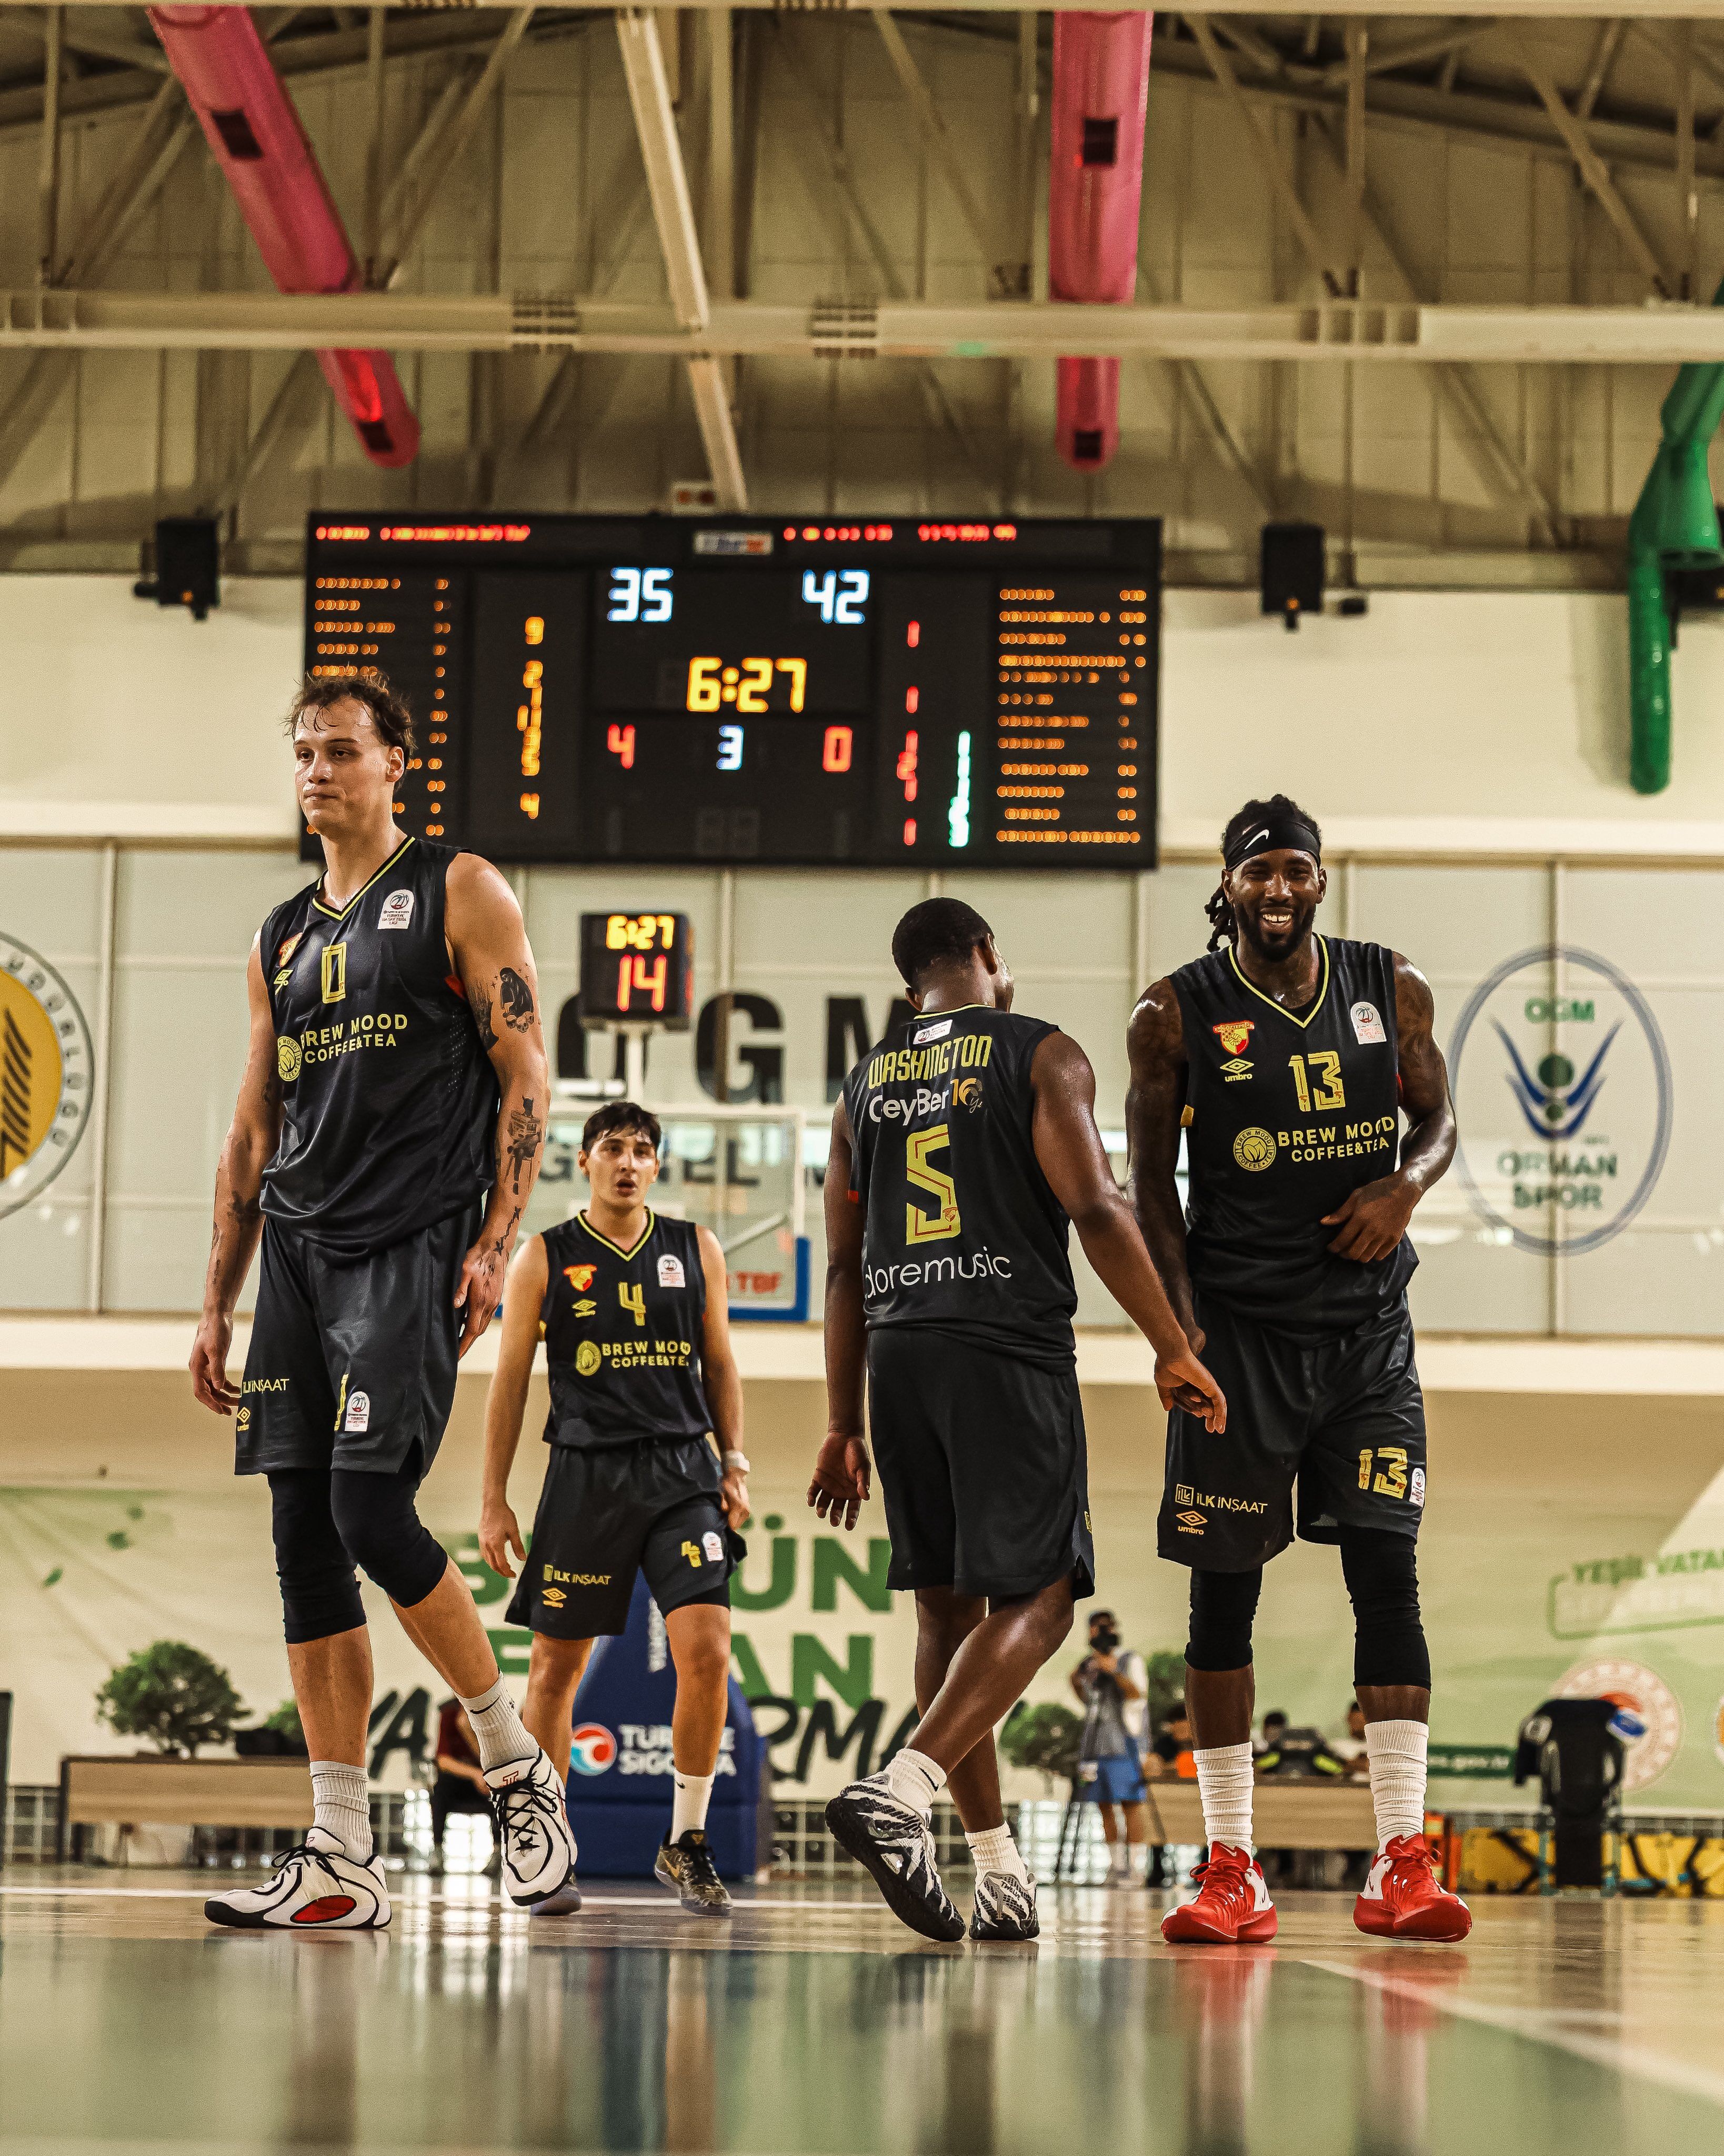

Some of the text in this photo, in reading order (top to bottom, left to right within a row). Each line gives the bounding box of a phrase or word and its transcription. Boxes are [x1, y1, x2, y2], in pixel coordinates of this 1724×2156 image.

[607, 567, 674, 622] 35
[802, 569, 870, 624] 42
[686, 657, 807, 713] 6:27
[607, 724, 636, 769] 4
[716, 724, 744, 771] 3
[822, 726, 853, 772] 0
[606, 914, 675, 950] 6:27
[322, 942, 347, 1004] 0
[617, 954, 667, 1011] 14
[351, 1014, 408, 1035] MOOD
[305, 1033, 397, 1063] COFFEE&TEA
[868, 1035, 992, 1090] WASHINGTON
[1225, 1073, 1252, 1082] umbro
[1288, 1051, 1346, 1112] 13
[869, 1089, 949, 1125] CeyBer
[1237, 1130, 1271, 1146] BREW MOOD
[1278, 1127, 1336, 1147] BREW
[1291, 1136, 1390, 1162] COFFEE&TEA
[1239, 1152, 1273, 1168] COFFEE TEA
[906, 1124, 961, 1245] 5
[866, 1247, 1012, 1299] doremusic
[618, 1282, 646, 1326] 4
[602, 1341, 648, 1356] BREW
[1358, 1447, 1408, 1499] 13
